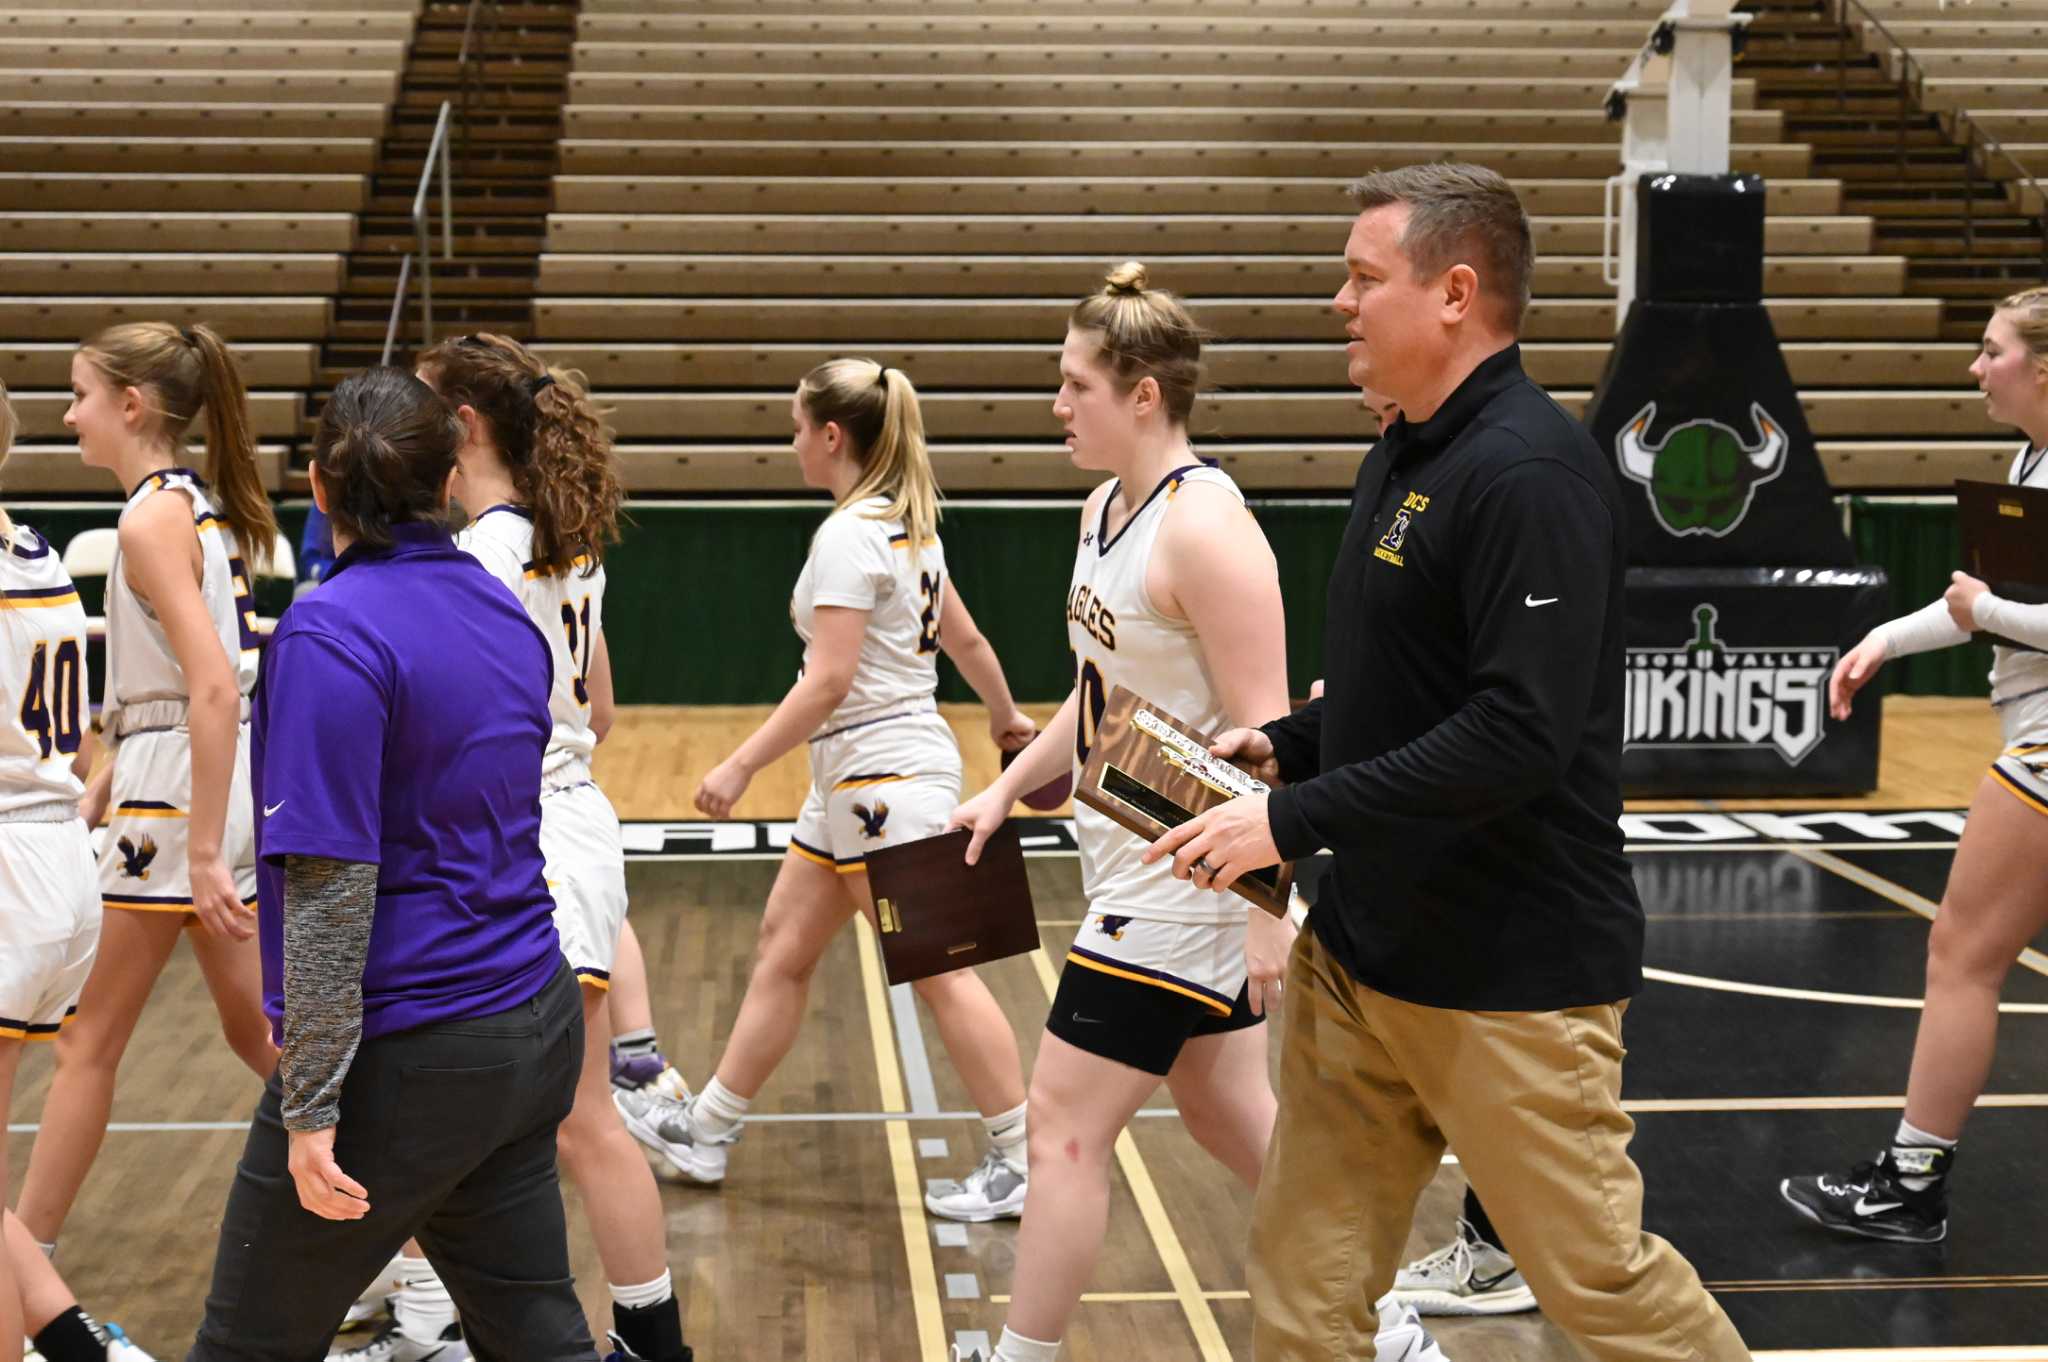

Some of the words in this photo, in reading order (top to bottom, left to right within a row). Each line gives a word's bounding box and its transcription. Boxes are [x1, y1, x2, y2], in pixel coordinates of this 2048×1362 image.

[1403, 491, 1430, 512] DCS
[1626, 654, 1688, 667] SON
[1723, 653, 1831, 667] VALLEY
[19, 637, 82, 761] 40
[1623, 668, 1829, 758] IKINGS
